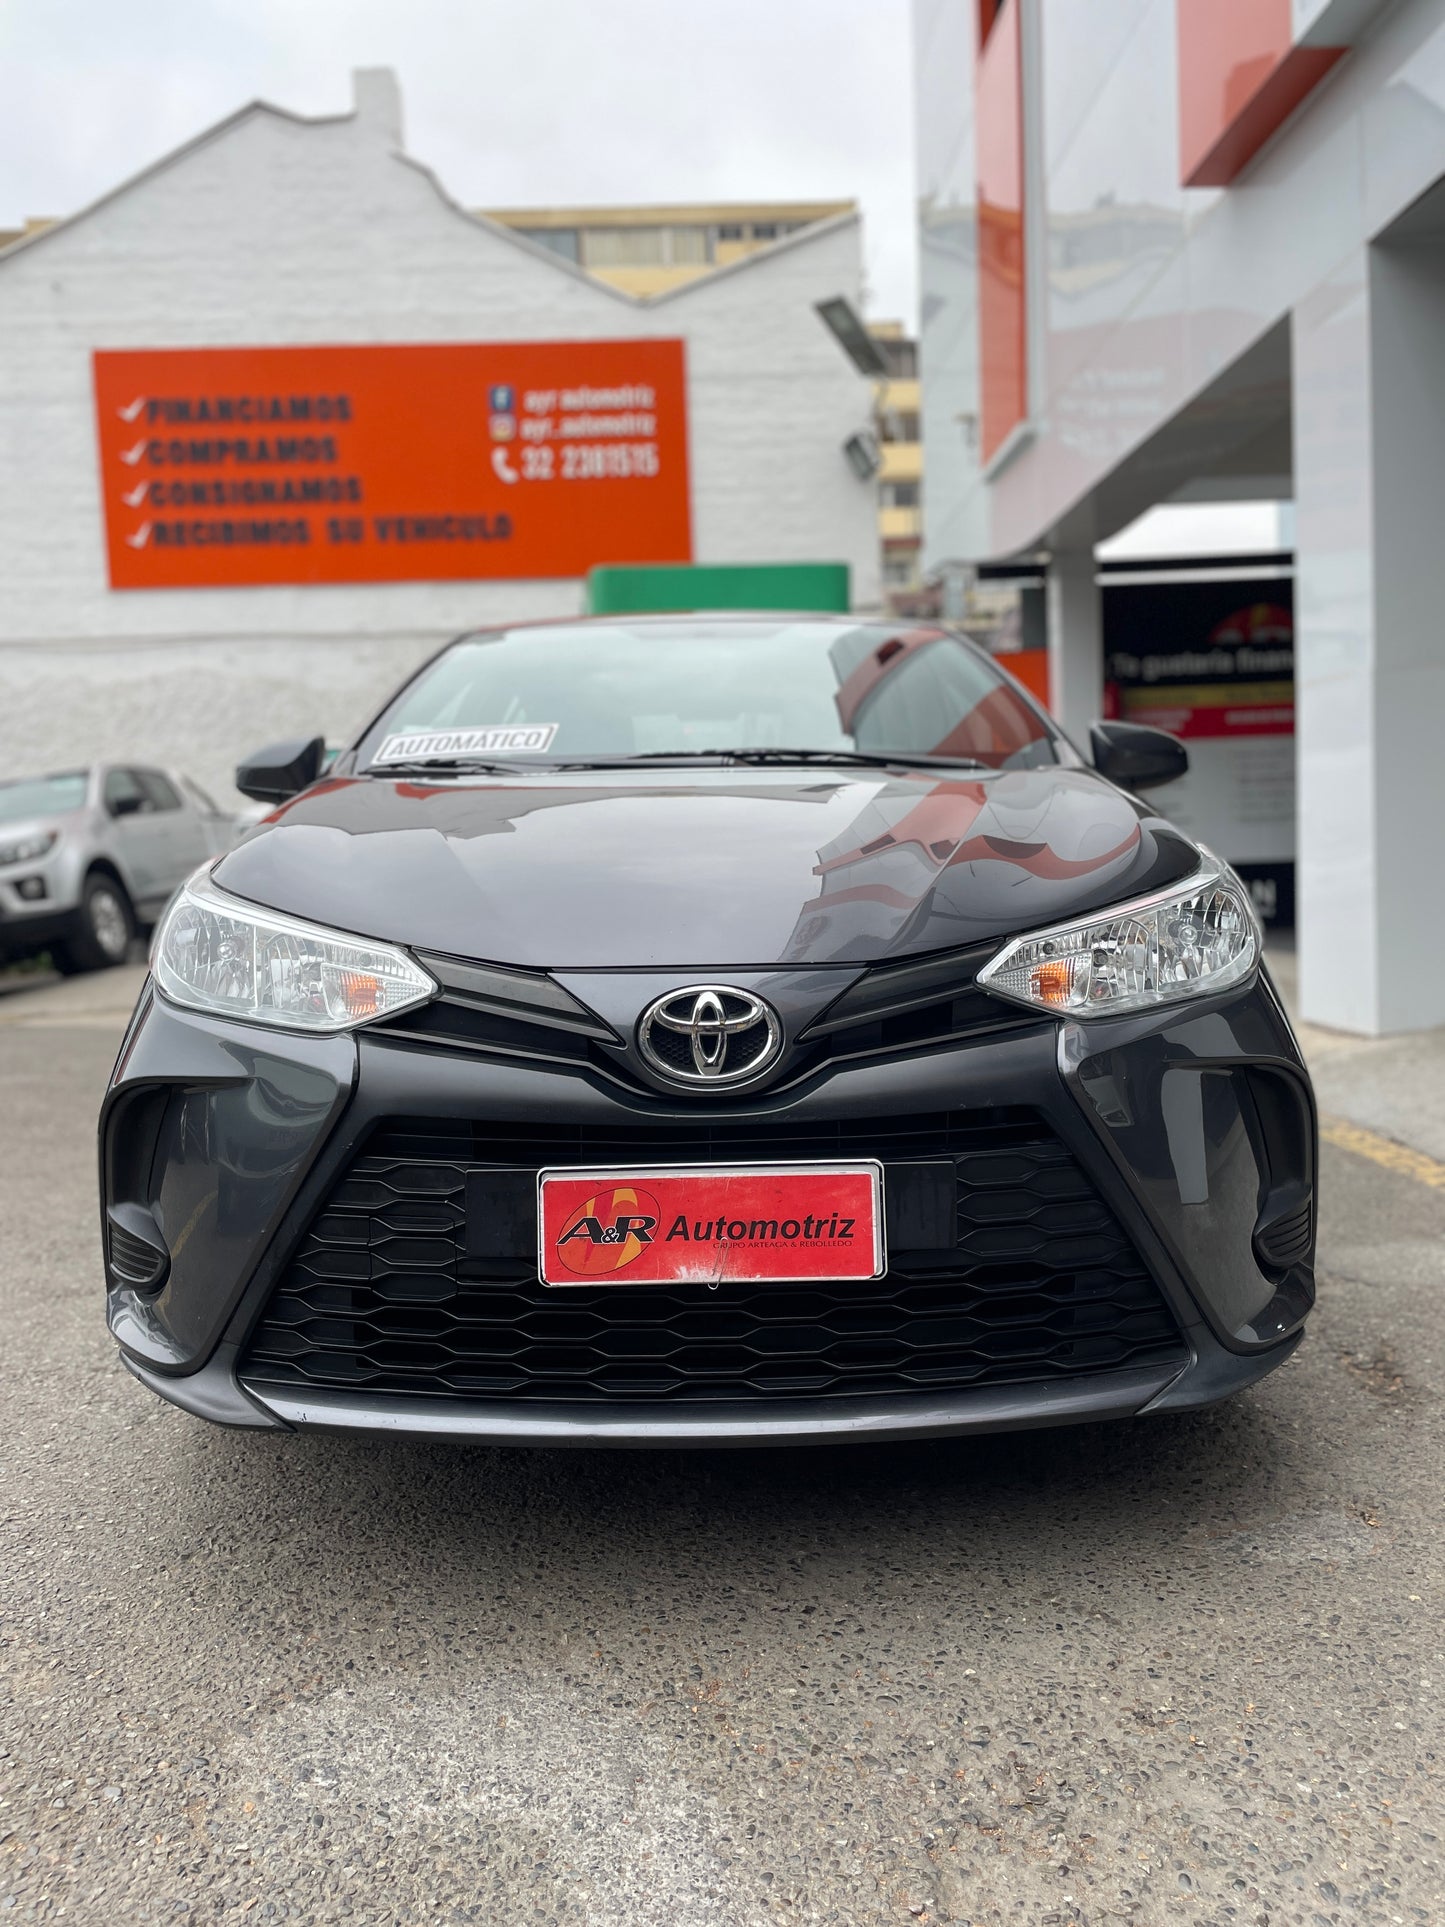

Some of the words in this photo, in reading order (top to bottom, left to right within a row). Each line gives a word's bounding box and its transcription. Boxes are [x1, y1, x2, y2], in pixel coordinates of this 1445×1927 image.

[147, 395, 352, 425] FINANCIAMOS
[148, 435, 336, 467] COMPRAMOS
[521, 446, 554, 479] 32
[150, 475, 361, 506] CONSIGNAMOS
[153, 516, 309, 547] RECIBIMOS
[327, 516, 364, 544] SU
[374, 512, 512, 542] VEHICULO
[556, 1215, 658, 1246] A&R
[665, 1212, 856, 1242] Automotriz
